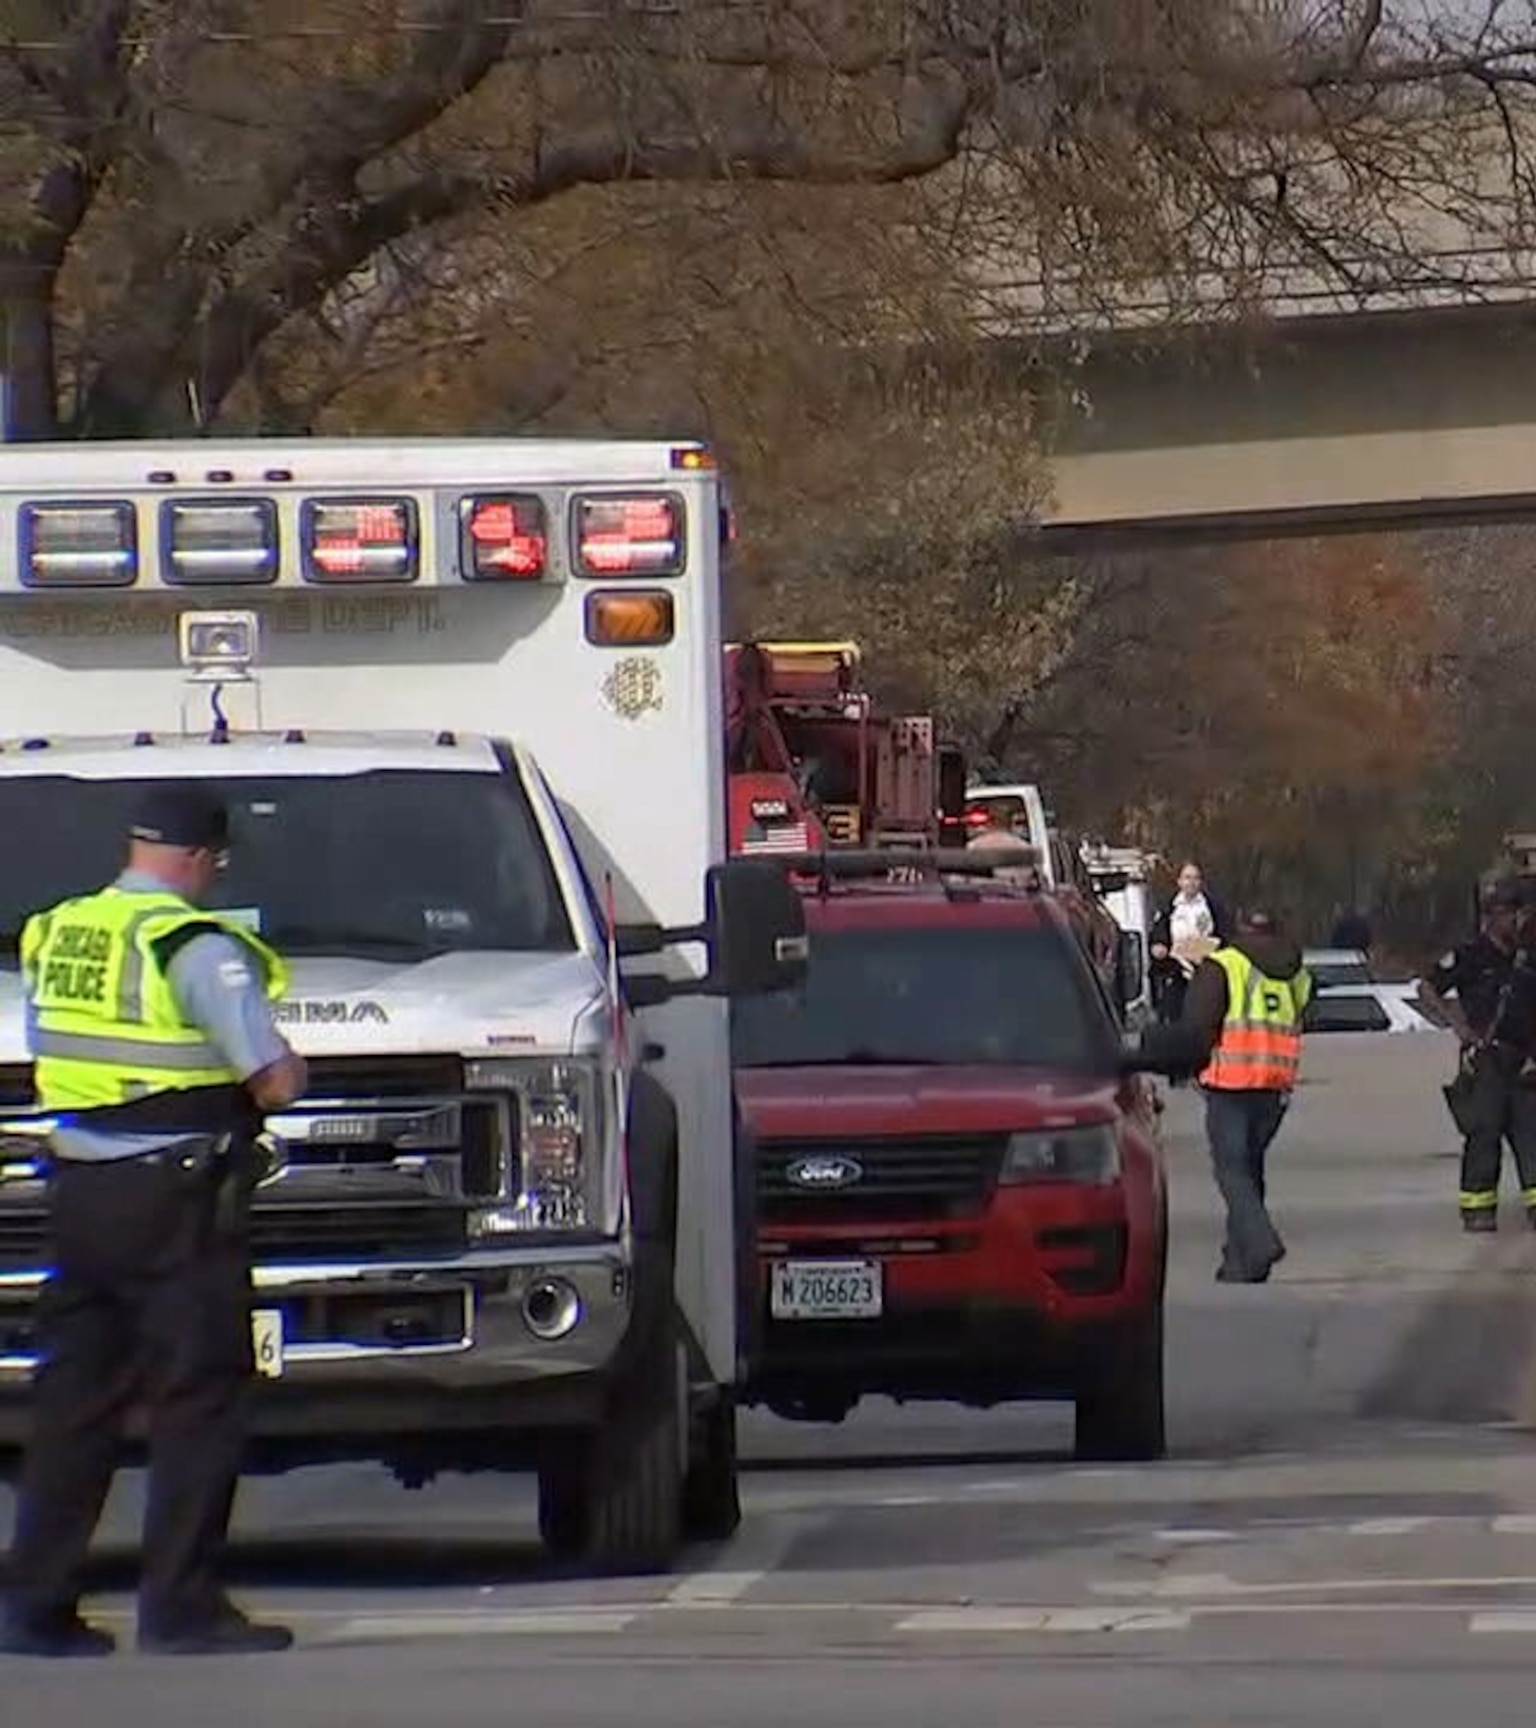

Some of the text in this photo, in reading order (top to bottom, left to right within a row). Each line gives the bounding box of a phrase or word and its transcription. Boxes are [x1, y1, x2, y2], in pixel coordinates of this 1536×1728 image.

[52, 924, 111, 962] CHICAGO
[43, 960, 107, 1002] POLICE
[800, 1277, 873, 1304] 206623
